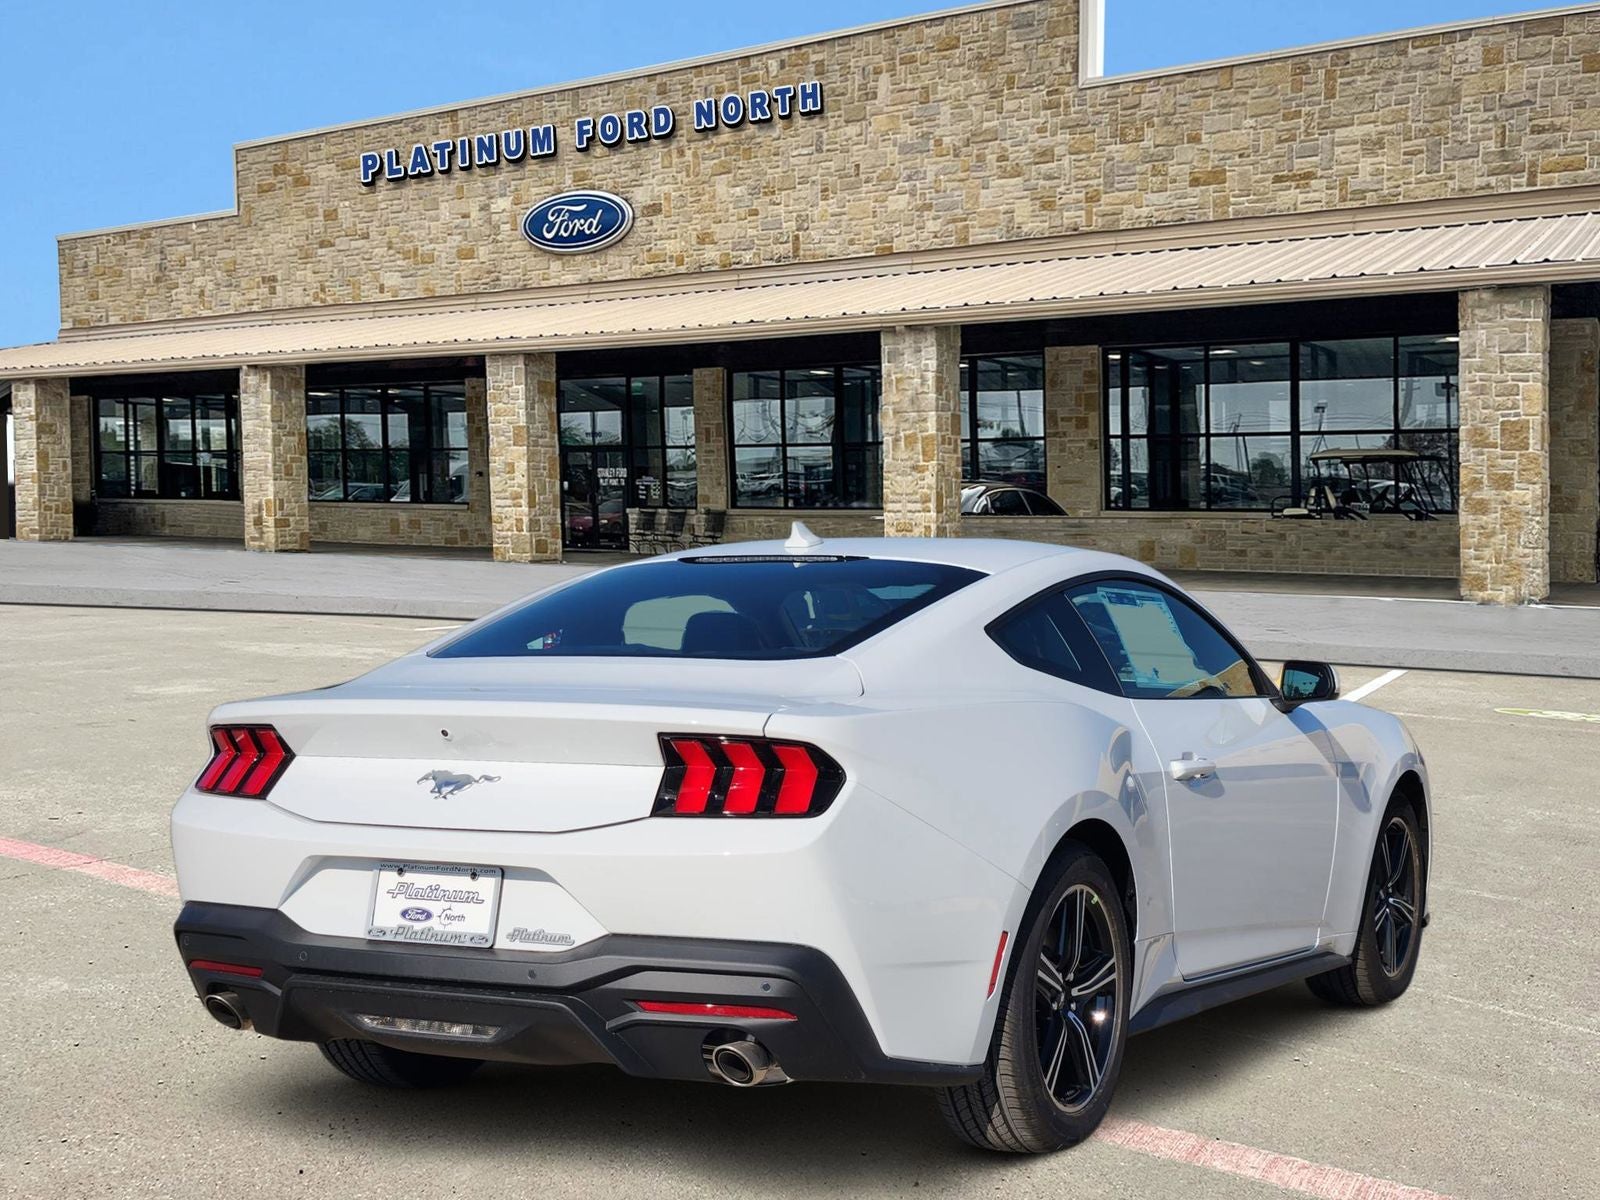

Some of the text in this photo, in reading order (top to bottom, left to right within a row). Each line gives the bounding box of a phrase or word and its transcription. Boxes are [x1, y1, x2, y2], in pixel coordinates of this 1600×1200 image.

[360, 80, 823, 186] PLATINUM FORD NORTH
[543, 203, 602, 240] Ford
[386, 881, 485, 904] Platinum
[444, 913, 466, 922] North
[506, 927, 575, 946] Platinum
